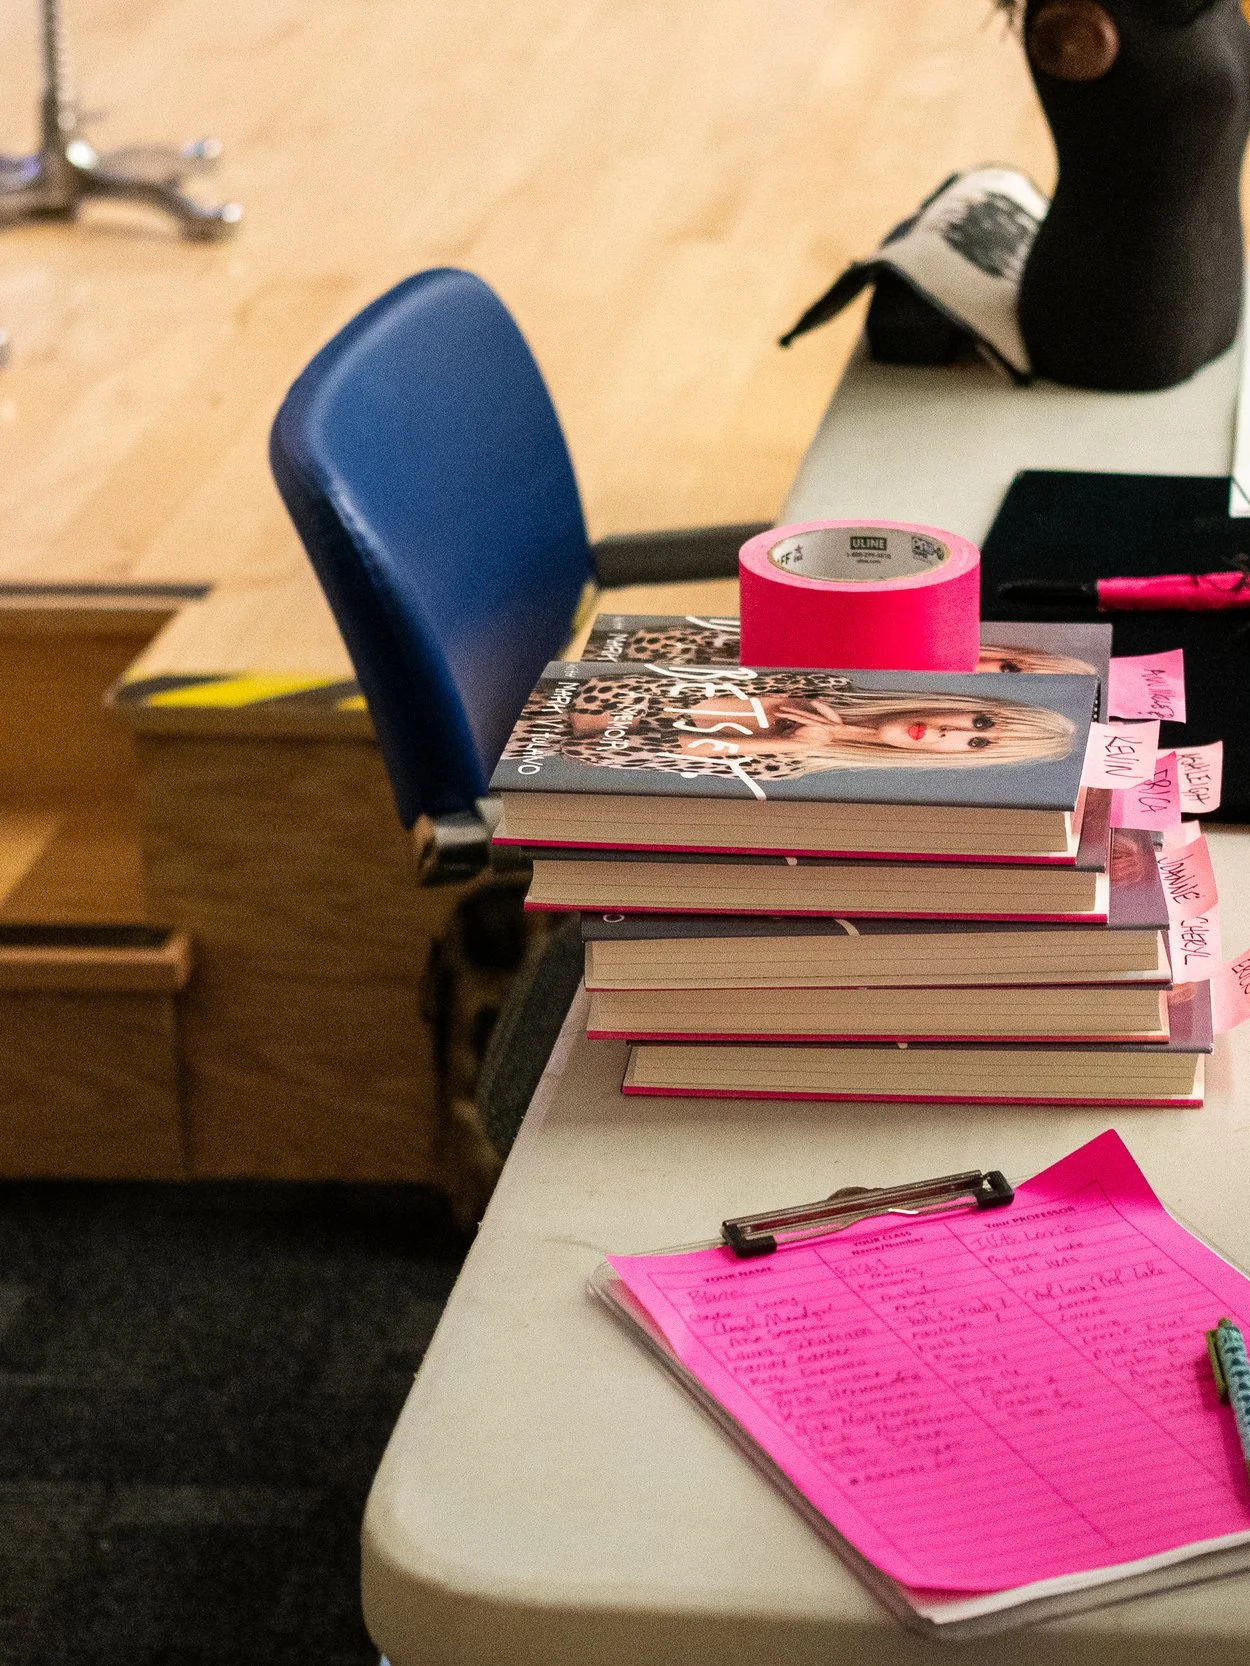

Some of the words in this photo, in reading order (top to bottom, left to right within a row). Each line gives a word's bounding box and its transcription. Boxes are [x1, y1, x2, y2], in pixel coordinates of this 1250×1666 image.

[852, 538, 887, 549] ULINE
[542, 682, 580, 714] MARK
[597, 702, 638, 751] MEMOIR
[1103, 735, 1143, 779] KEVIN
[1157, 854, 1200, 905] JOANNE
[1180, 916, 1212, 966] CHERYL
[1012, 1206, 1074, 1223] PROFESSOR
[851, 1237, 923, 1255] Name/Number
